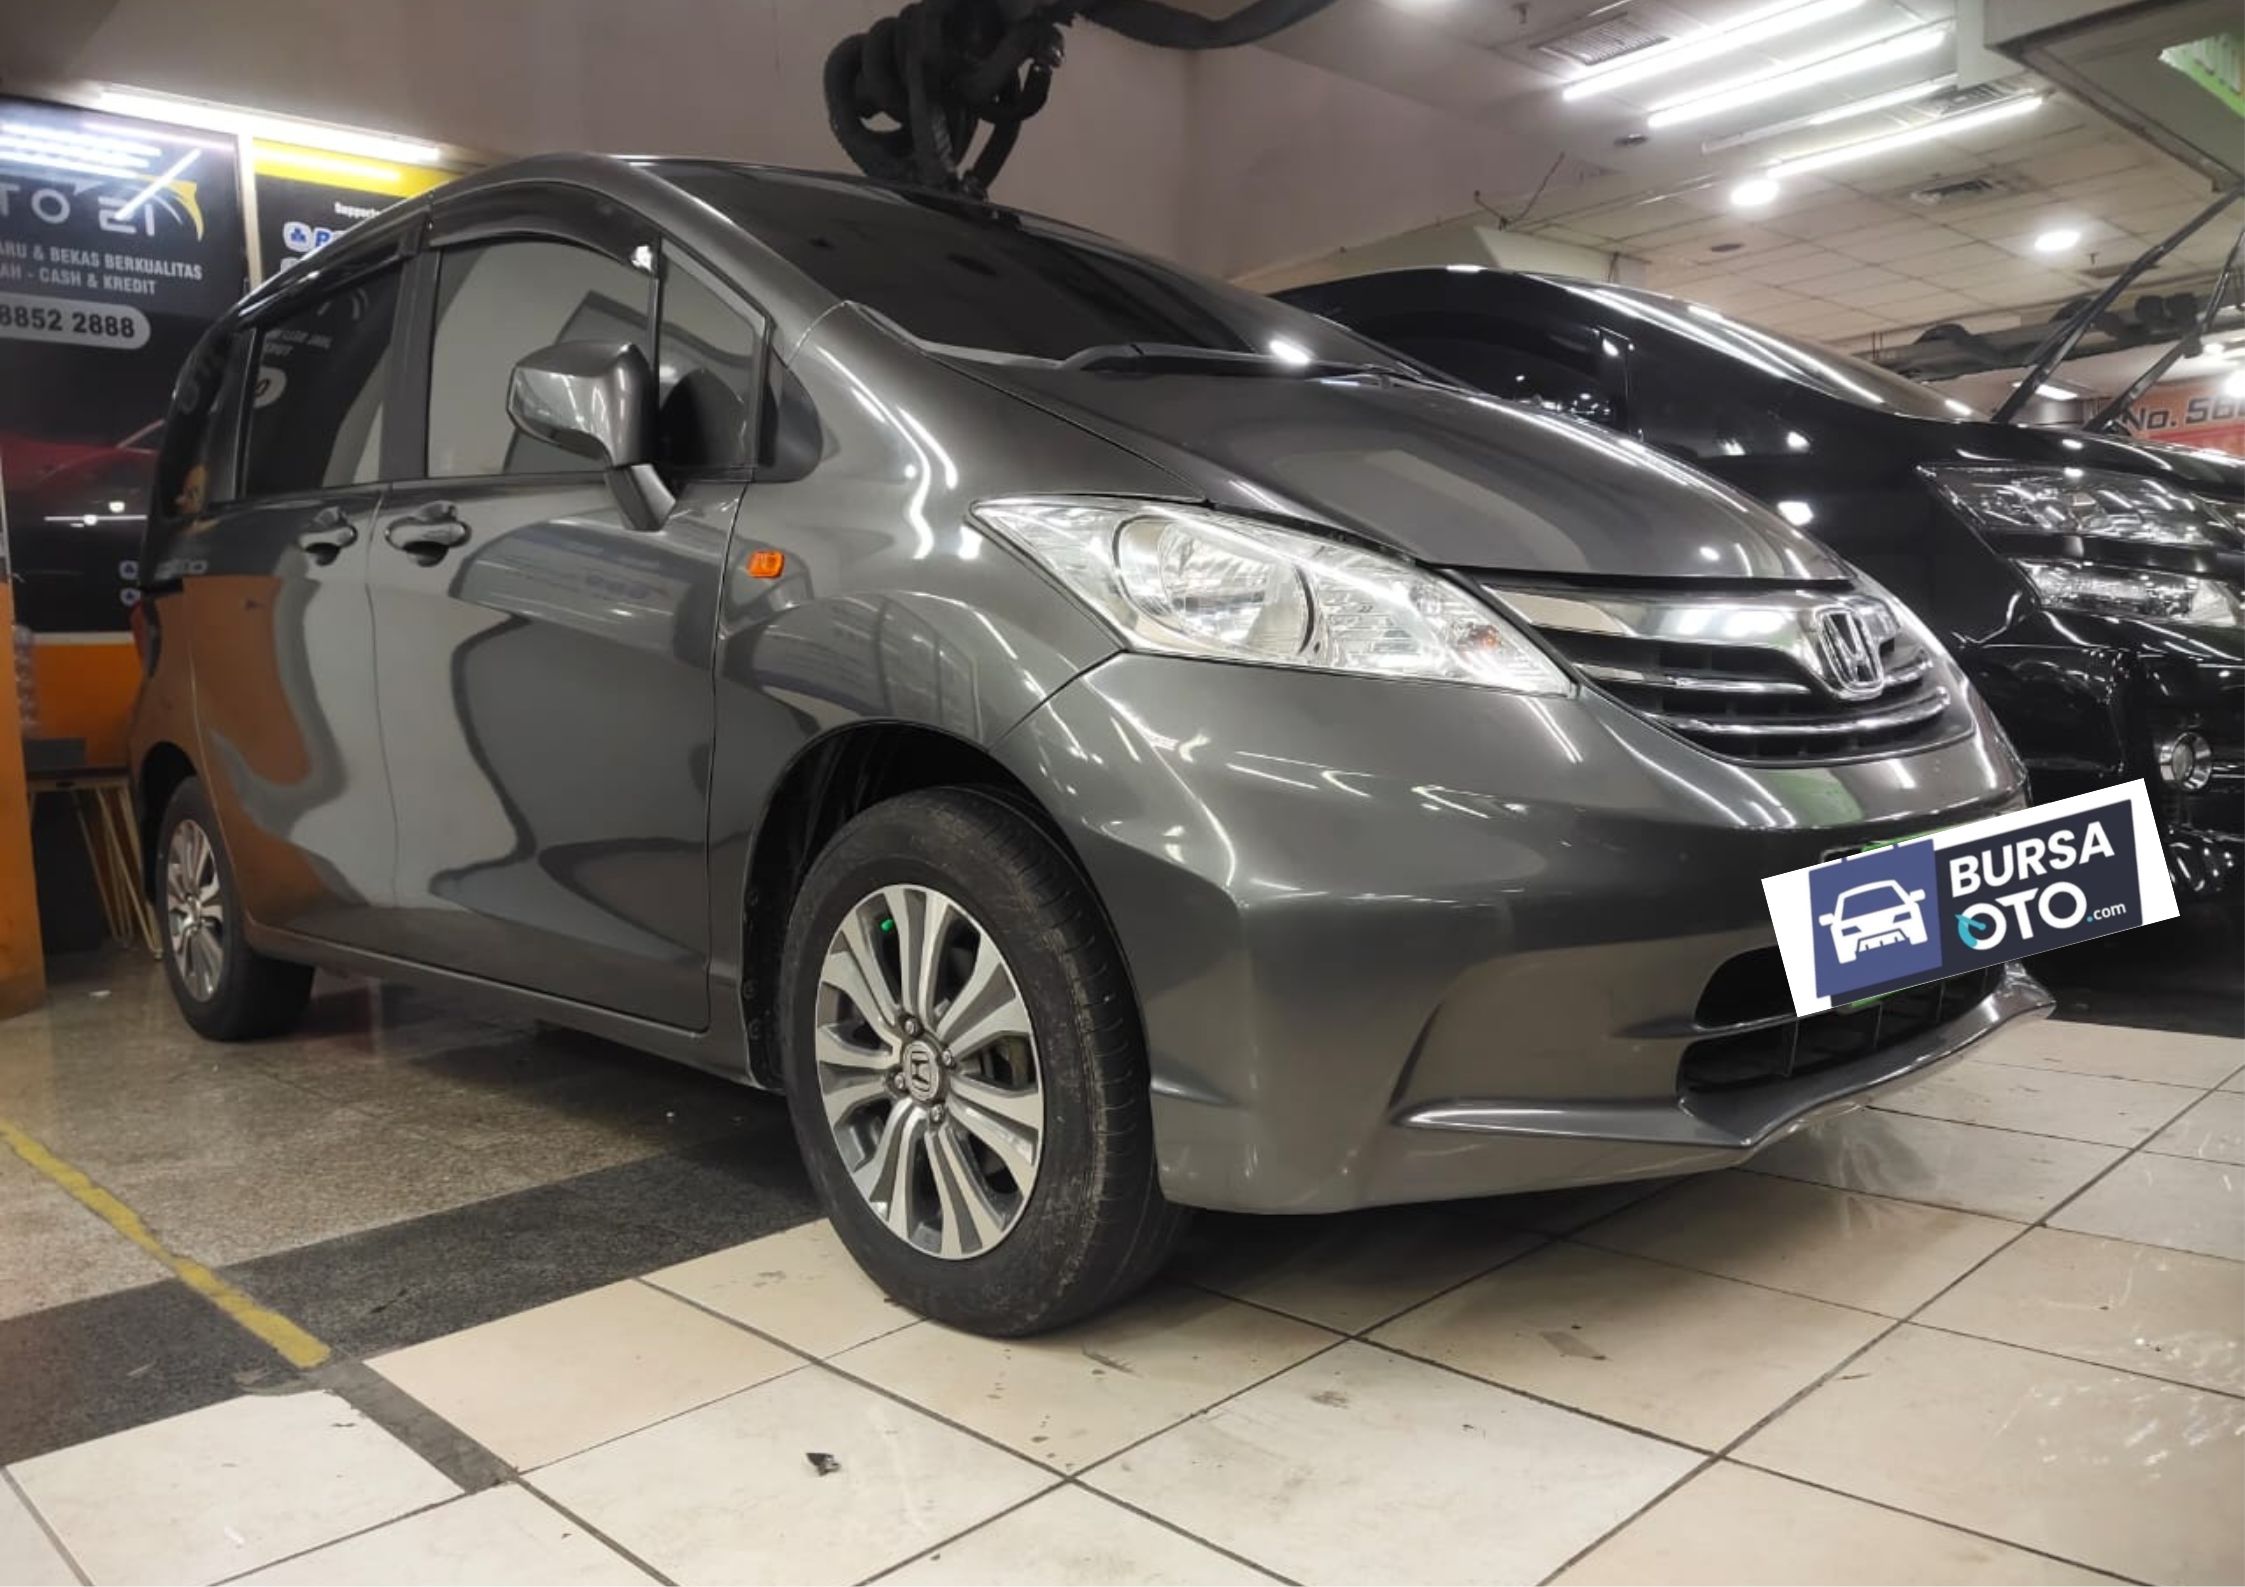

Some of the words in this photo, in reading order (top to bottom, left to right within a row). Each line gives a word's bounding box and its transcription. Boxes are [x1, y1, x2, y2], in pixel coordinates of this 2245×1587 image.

[33, 245, 45, 262] &
[50, 246, 100, 268] BEKAS
[104, 253, 203, 281] BERKUALITAS
[40, 267, 82, 287] CASH
[87, 273, 99, 289] &
[103, 274, 157, 295] KREDIT
[72, 311, 135, 339] 2888
